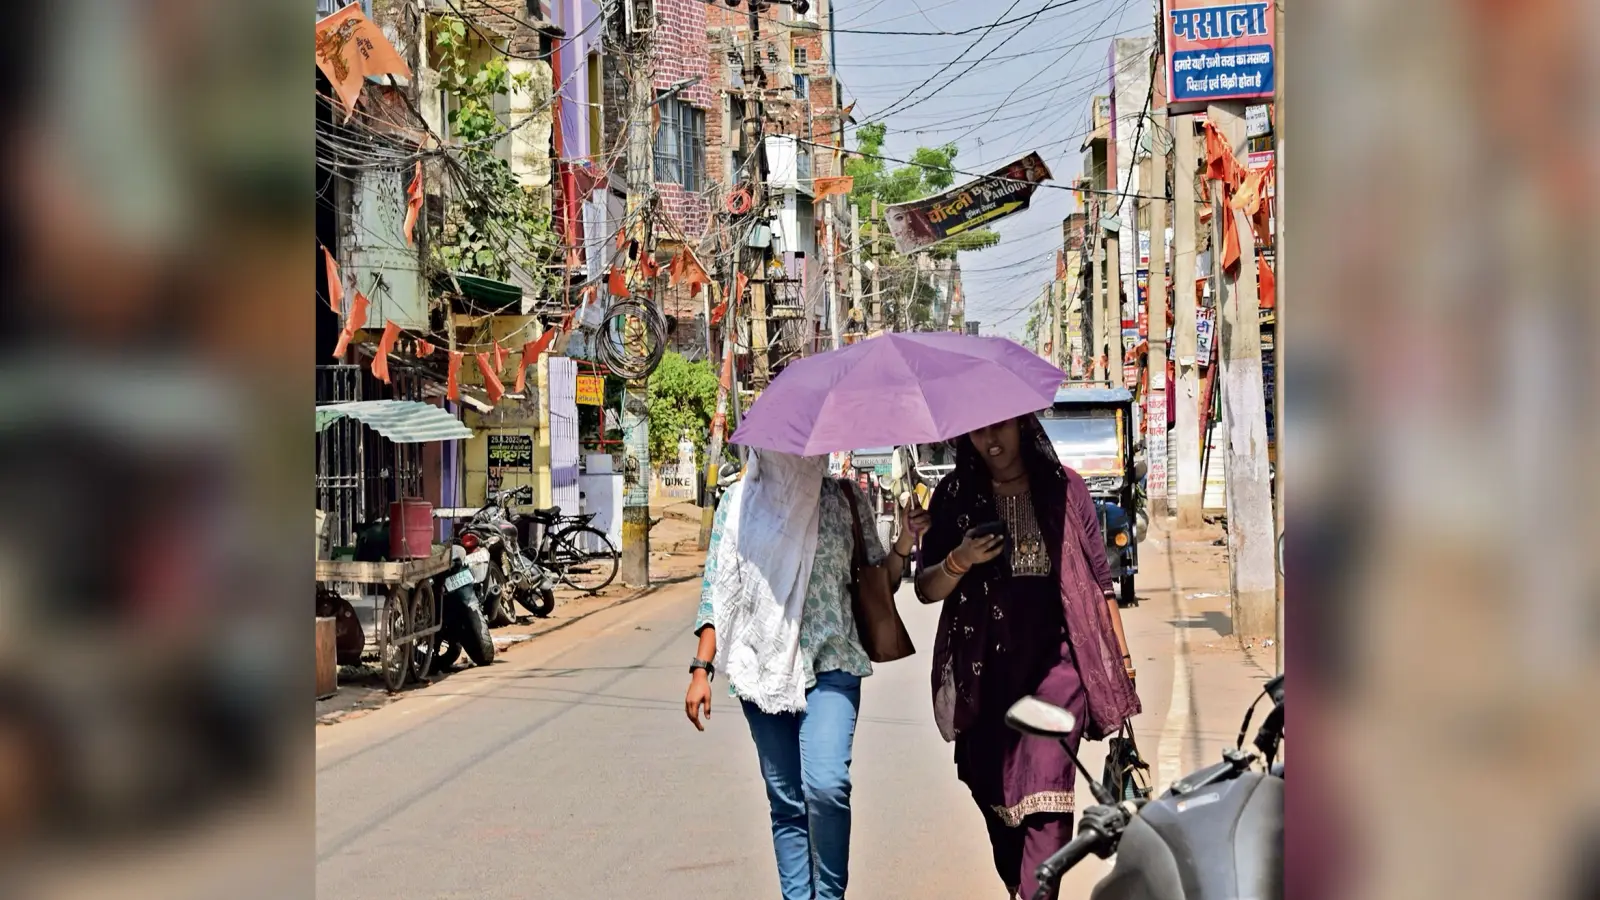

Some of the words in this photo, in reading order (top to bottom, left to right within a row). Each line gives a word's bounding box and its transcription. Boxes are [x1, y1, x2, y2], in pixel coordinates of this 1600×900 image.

[1170, 2, 1269, 41] मसाला
[1174, 56, 1191, 72] हमारे
[1206, 53, 1220, 68] सभी
[1236, 54, 1246, 65] का
[1209, 74, 1219, 90] एवं
[1255, 71, 1262, 87] है
[489, 450, 532, 462] जादूगर
